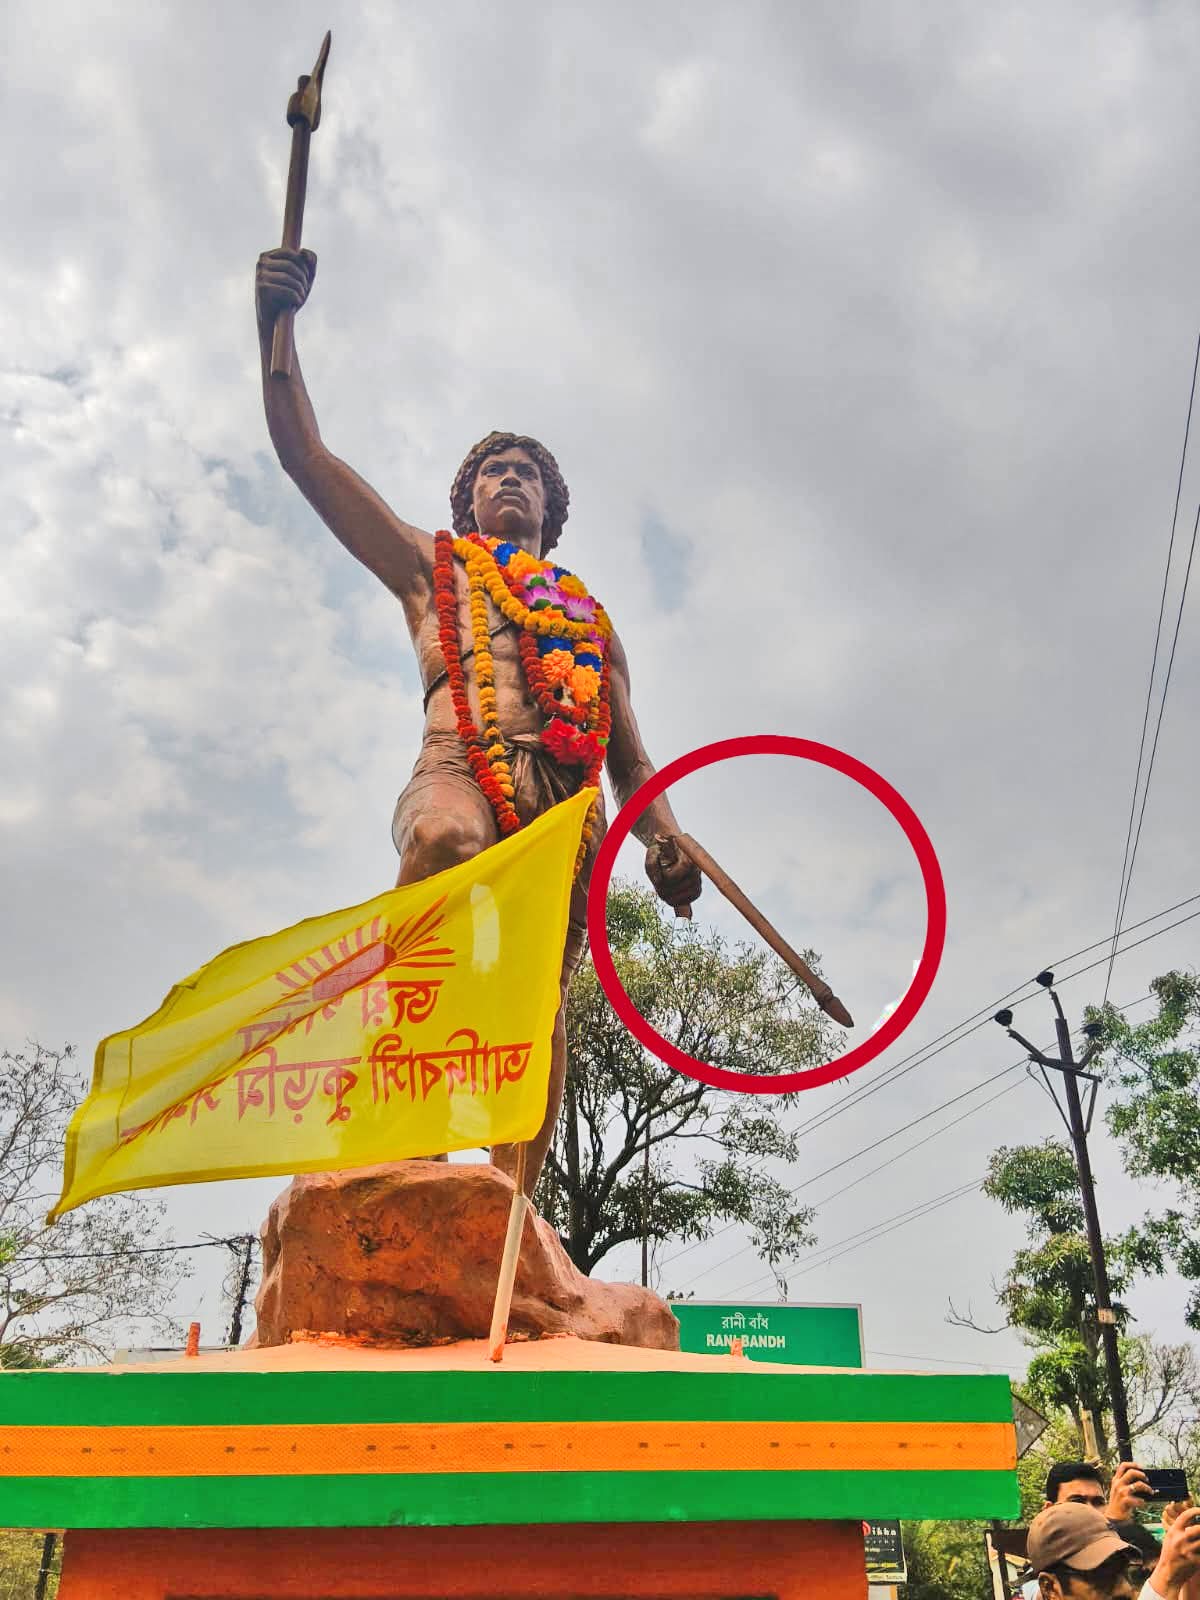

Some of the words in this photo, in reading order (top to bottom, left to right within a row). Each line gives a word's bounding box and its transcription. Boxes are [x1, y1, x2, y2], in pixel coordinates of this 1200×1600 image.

[721, 1312, 746, 1329] রানী
[749, 1312, 769, 1329] বাঁধ
[741, 1334, 786, 1348] BANDH
